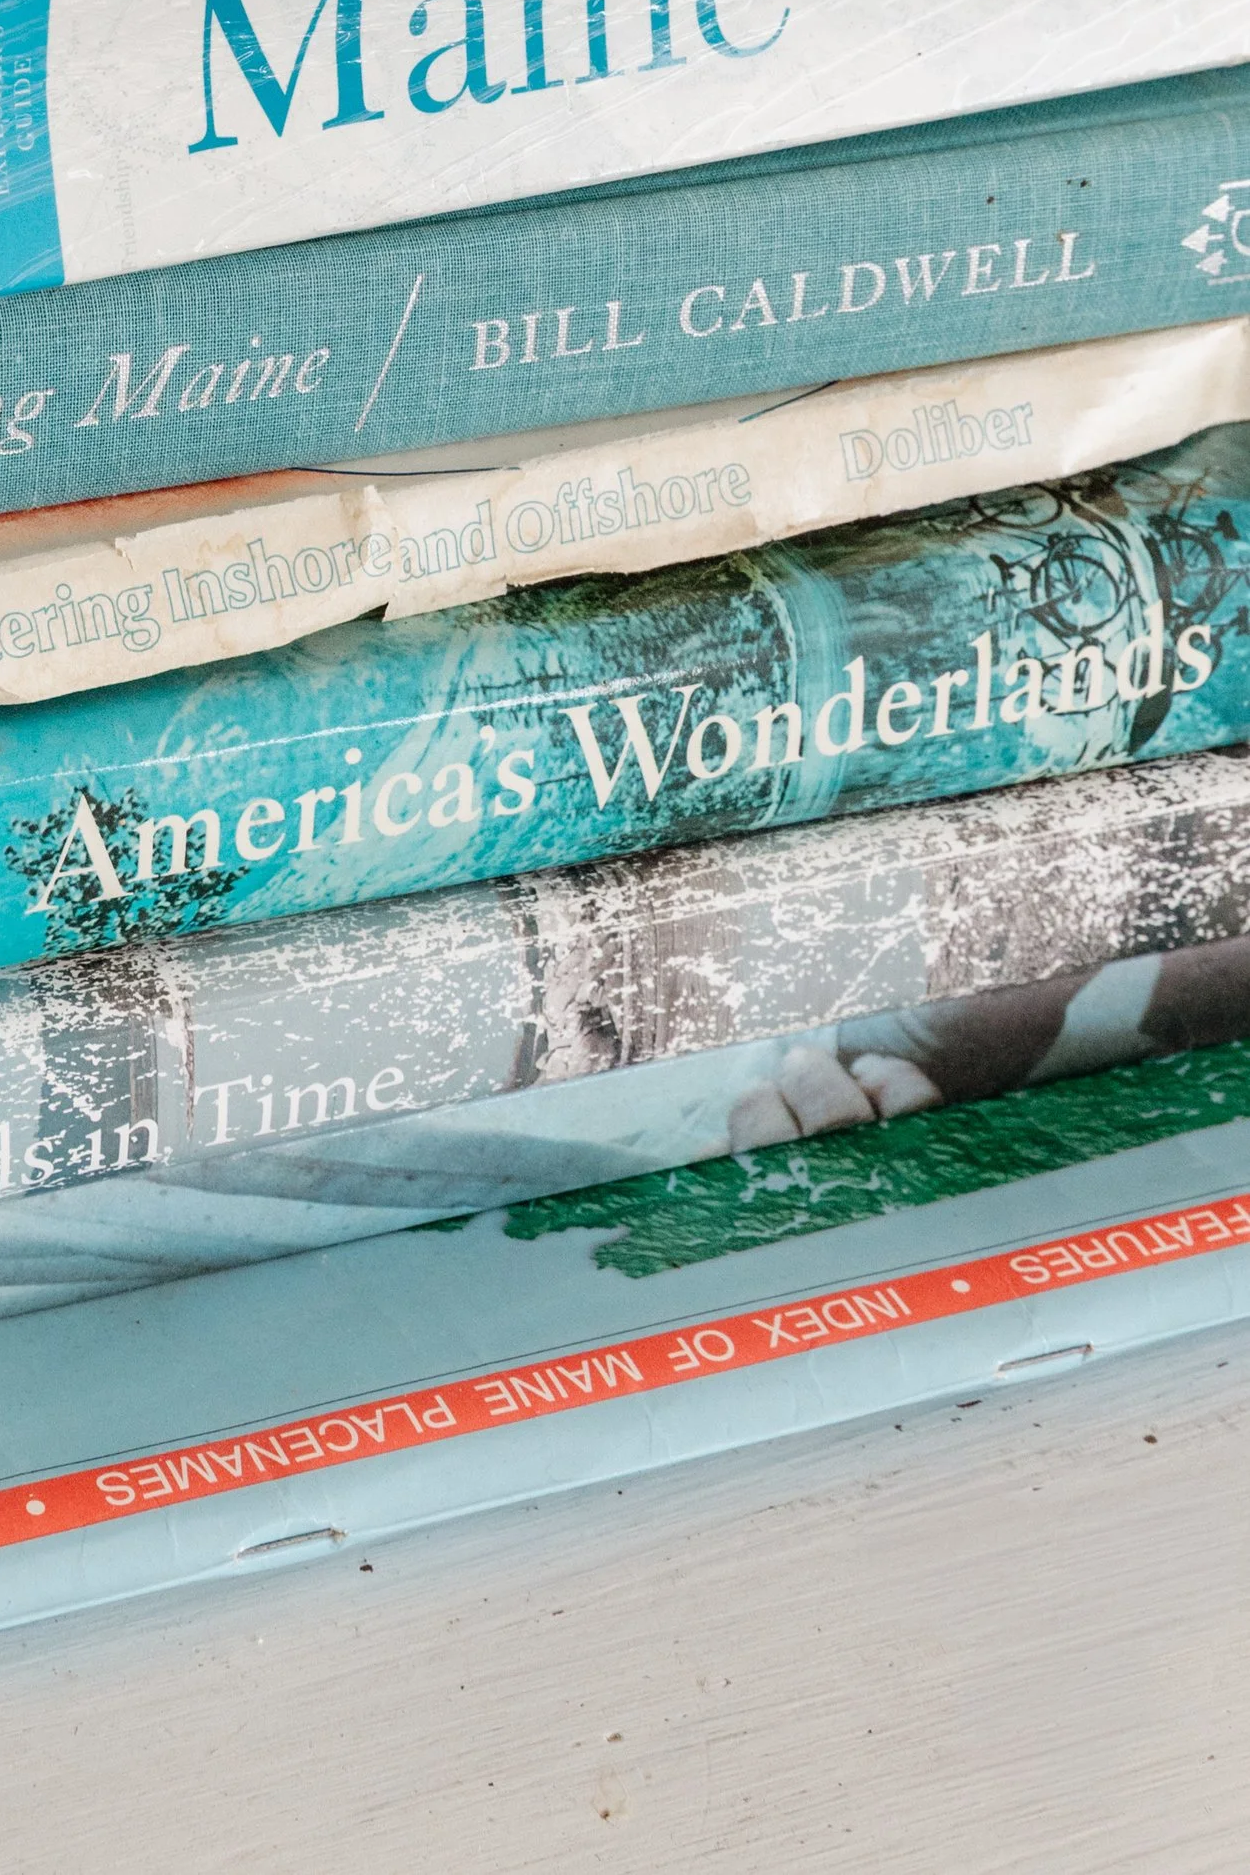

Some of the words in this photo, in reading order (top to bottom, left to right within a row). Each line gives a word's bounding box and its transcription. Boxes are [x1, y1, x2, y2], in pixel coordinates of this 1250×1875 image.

[13, 57, 35, 152] GUIDE
[74, 335, 330, 428] Maine
[468, 299, 647, 372] BILL
[679, 230, 1097, 339] CALDWELL
[161, 532, 393, 623] Inshore
[398, 498, 498, 584] and
[505, 460, 752, 554] Offshore
[839, 398, 1034, 483] Doliber
[24, 725, 537, 915] America's
[561, 601, 1212, 812] Wonderlands
[77, 1109, 164, 1176] in
[190, 1066, 408, 1148] Time
[1009, 1202, 1250, 1285] FEATURES
[668, 1328, 735, 1372] OF
[751, 1286, 912, 1349] INDEX
[482, 1351, 641, 1417] MAINE
[96, 1392, 457, 1507] PLACENAMES
